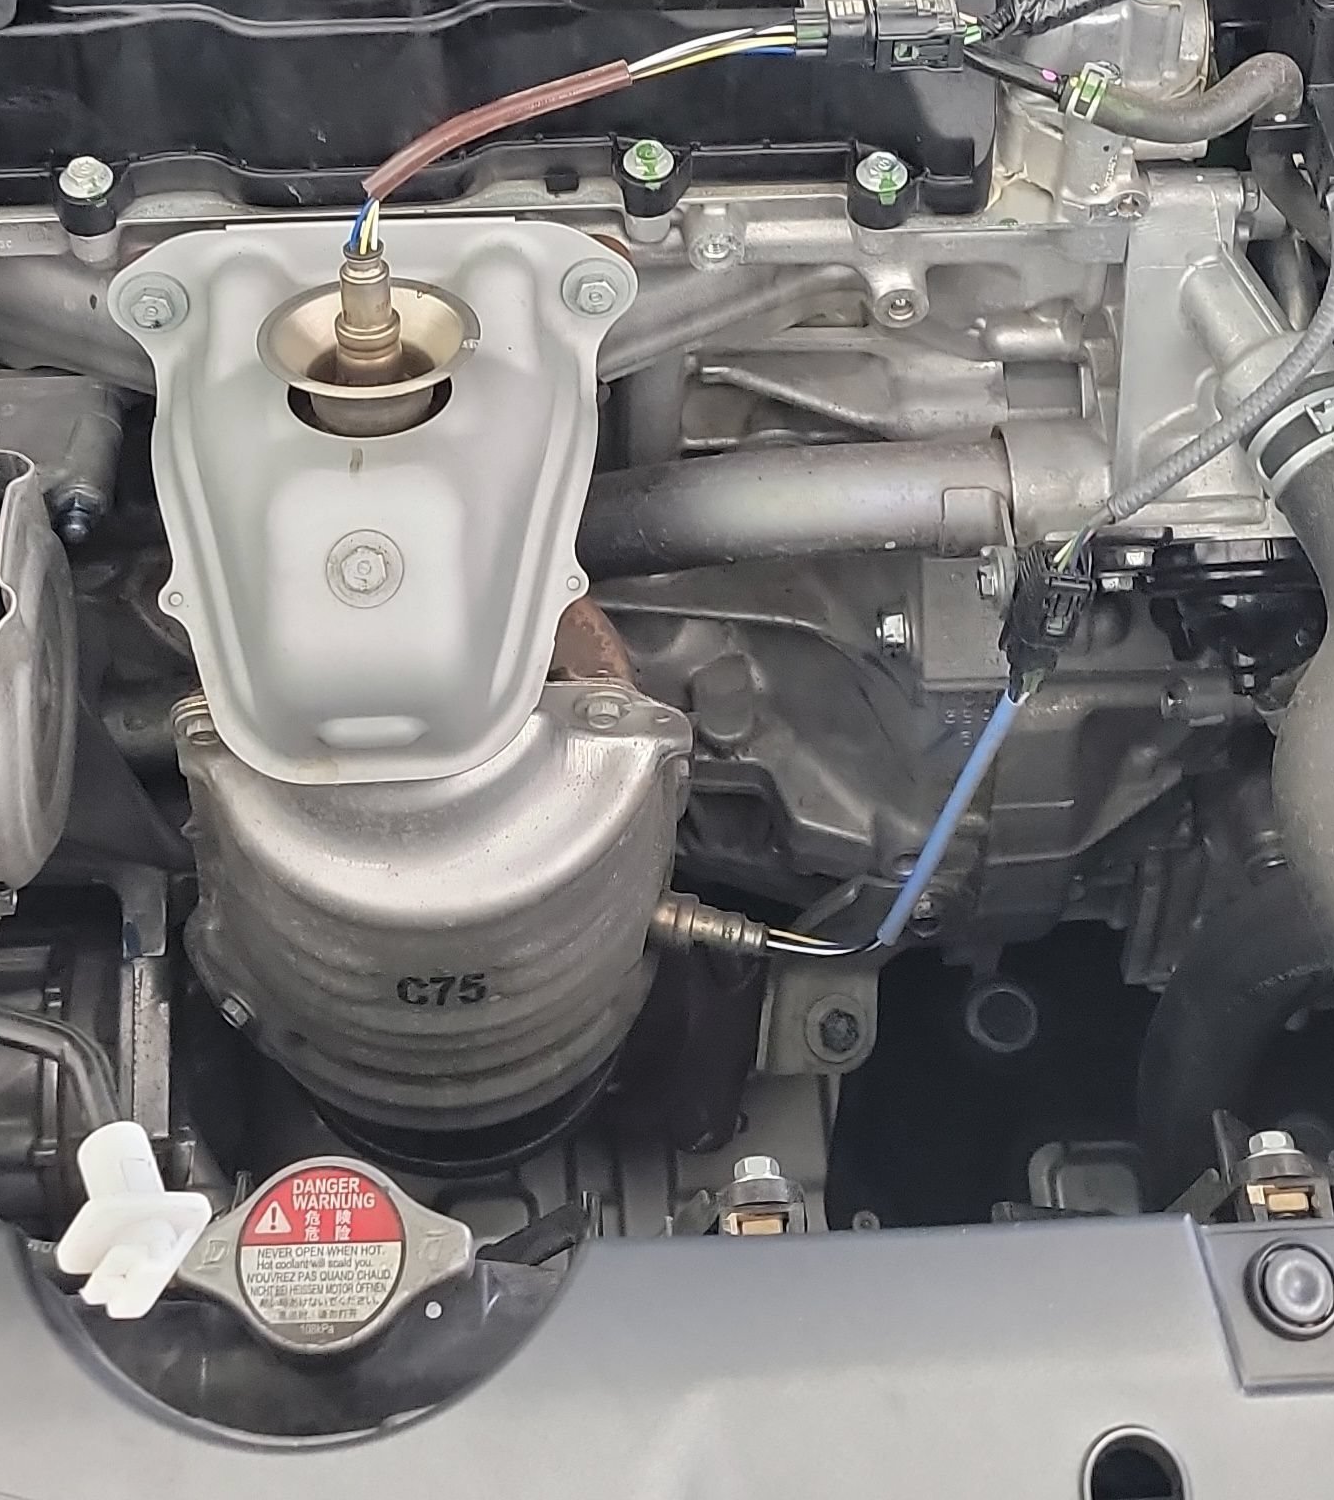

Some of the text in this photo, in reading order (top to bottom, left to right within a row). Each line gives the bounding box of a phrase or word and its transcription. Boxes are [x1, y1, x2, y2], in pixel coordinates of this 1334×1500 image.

[396, 973, 487, 1006] C75
[292, 1177, 360, 1194] DANGER
[292, 1193, 376, 1210] WARNUNG
[257, 1248, 292, 1259] NEVER
[295, 1246, 325, 1258] OPEN
[327, 1245, 358, 1257] WHEN
[257, 1259, 273, 1270] Hot
[298, 1271, 318, 1282] PAS
[320, 1270, 354, 1281] QUAND
